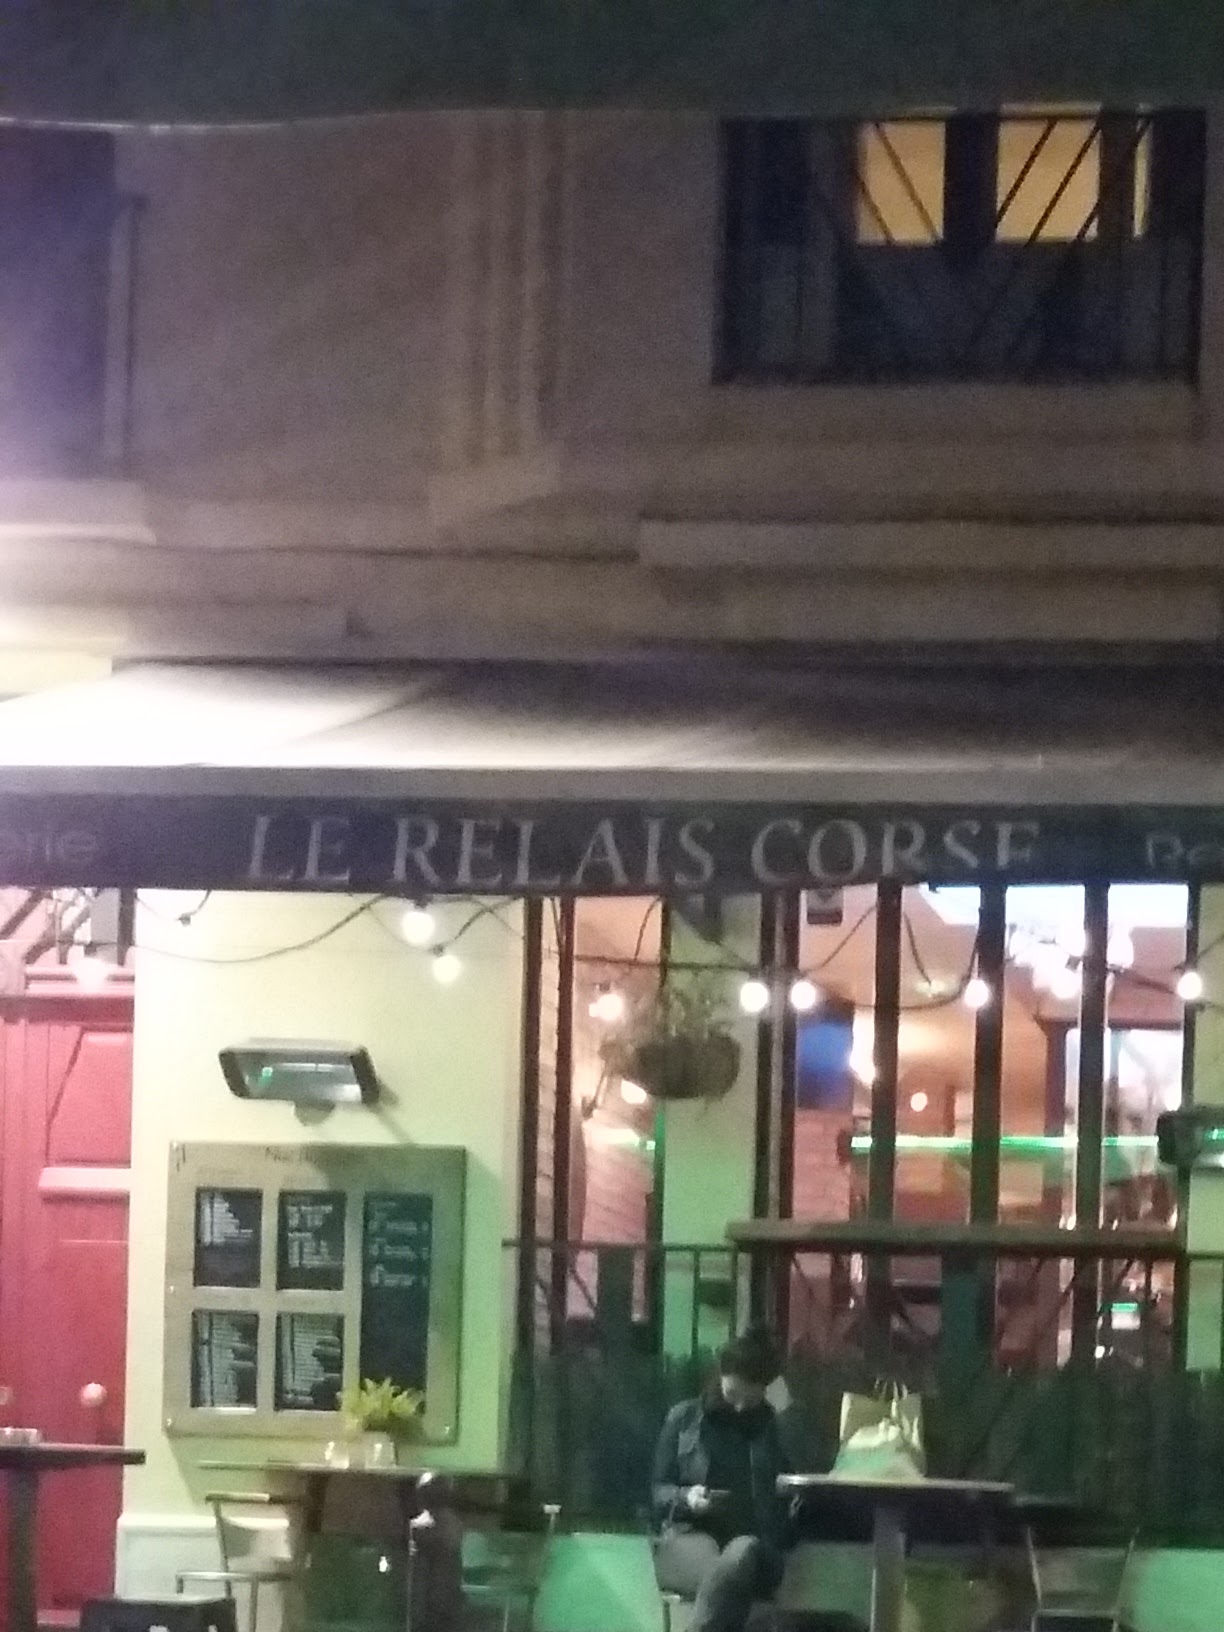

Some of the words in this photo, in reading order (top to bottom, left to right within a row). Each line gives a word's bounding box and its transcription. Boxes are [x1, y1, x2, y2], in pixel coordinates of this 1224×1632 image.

[247, 813, 351, 882] LE
[388, 814, 716, 887] RELAIS
[750, 817, 1041, 884] CORSE
